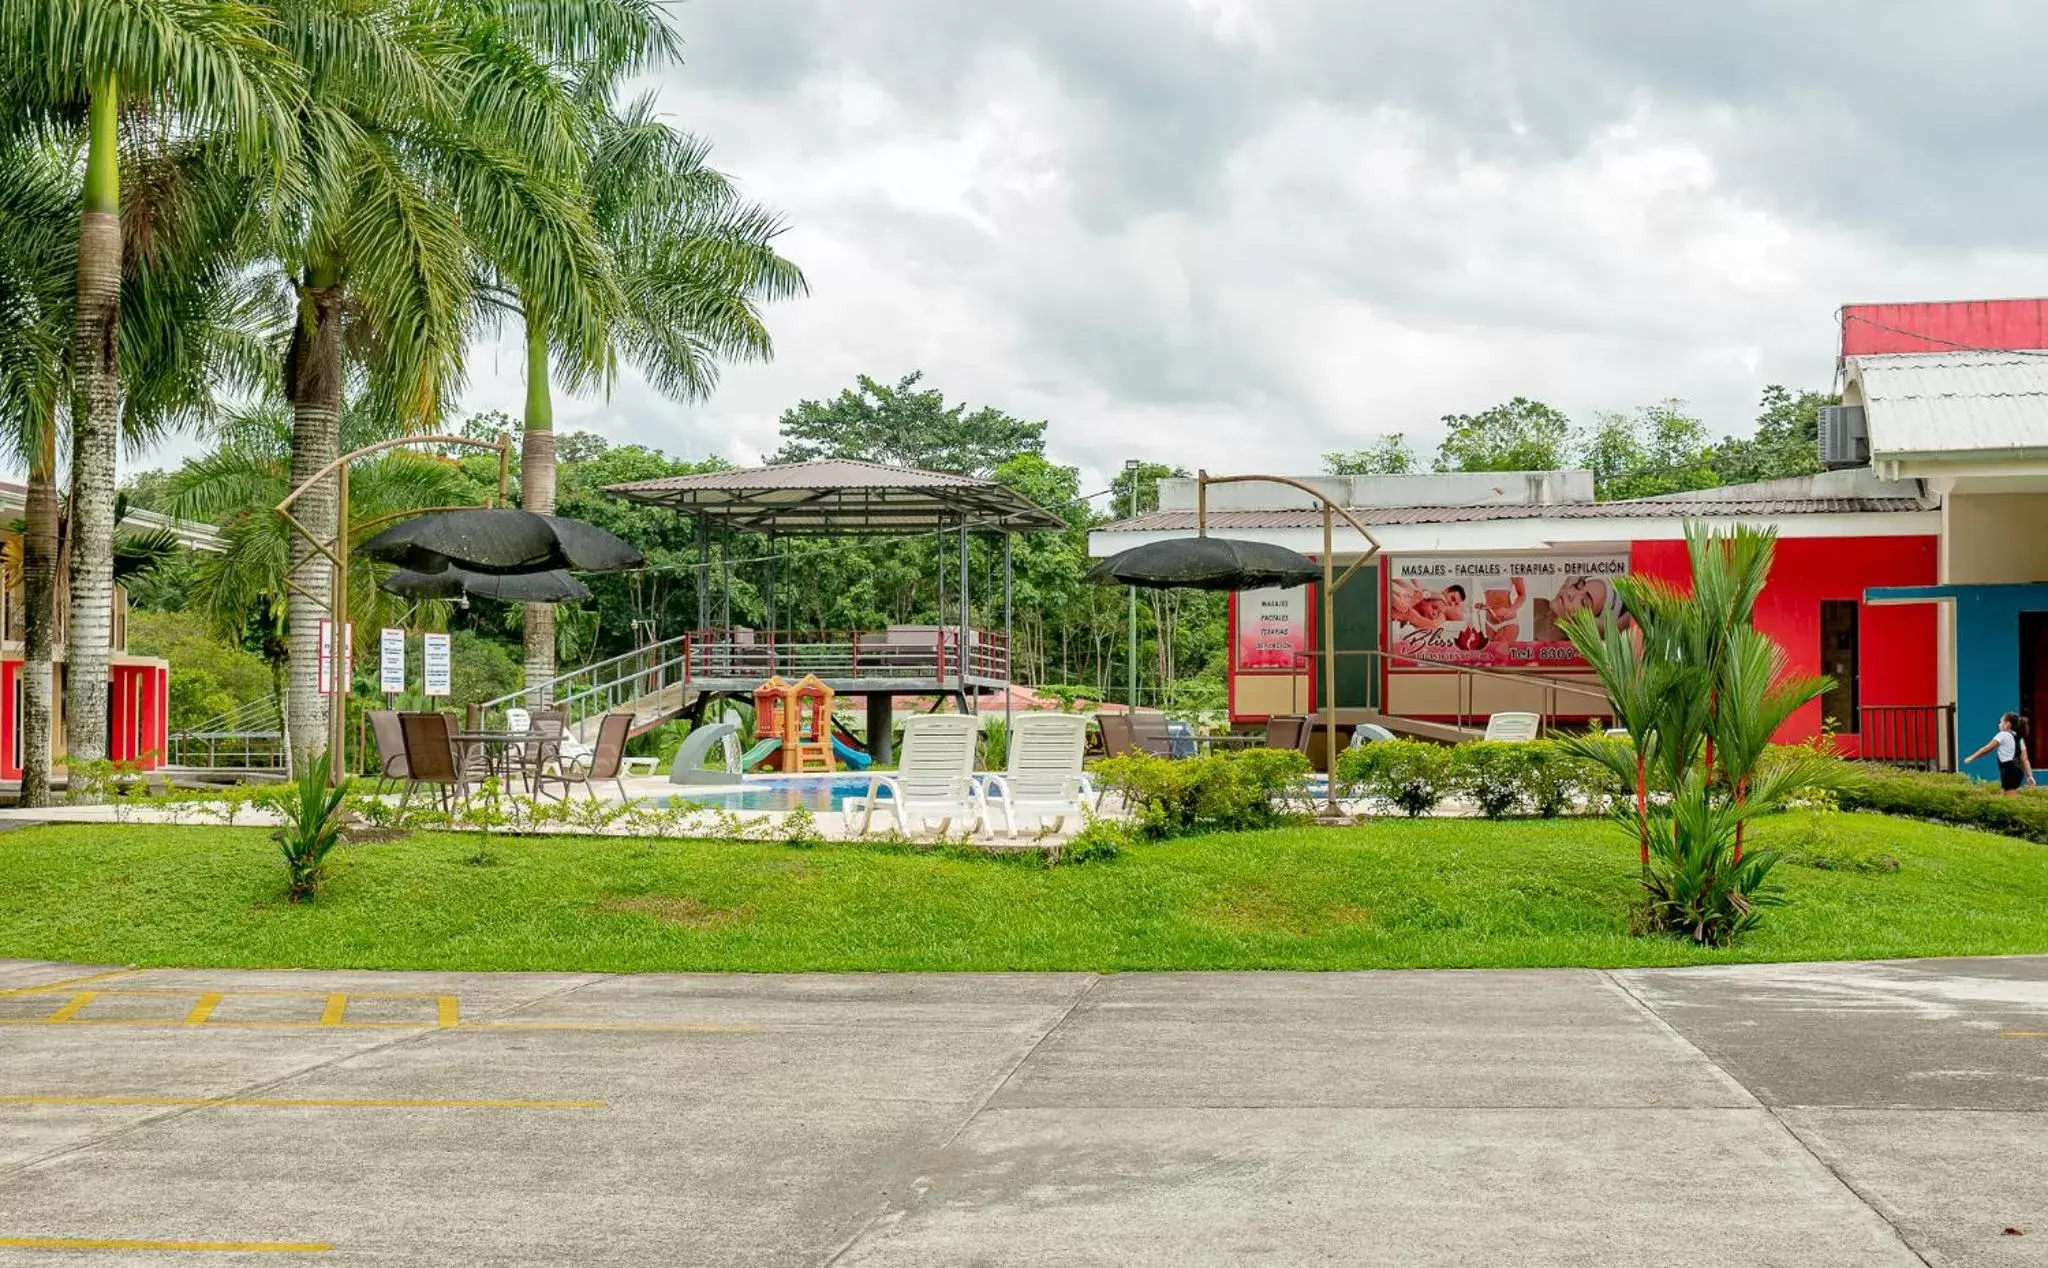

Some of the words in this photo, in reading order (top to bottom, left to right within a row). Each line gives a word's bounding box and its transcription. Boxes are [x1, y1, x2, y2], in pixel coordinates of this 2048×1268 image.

[1401, 564, 1446, 576] MASAJES
[1455, 563, 1500, 576] FACIALES
[1510, 563, 1555, 575] TERAPIAS
[1564, 560, 1625, 574] DEPILACIÓN
[1401, 627, 1453, 655] Bliss
